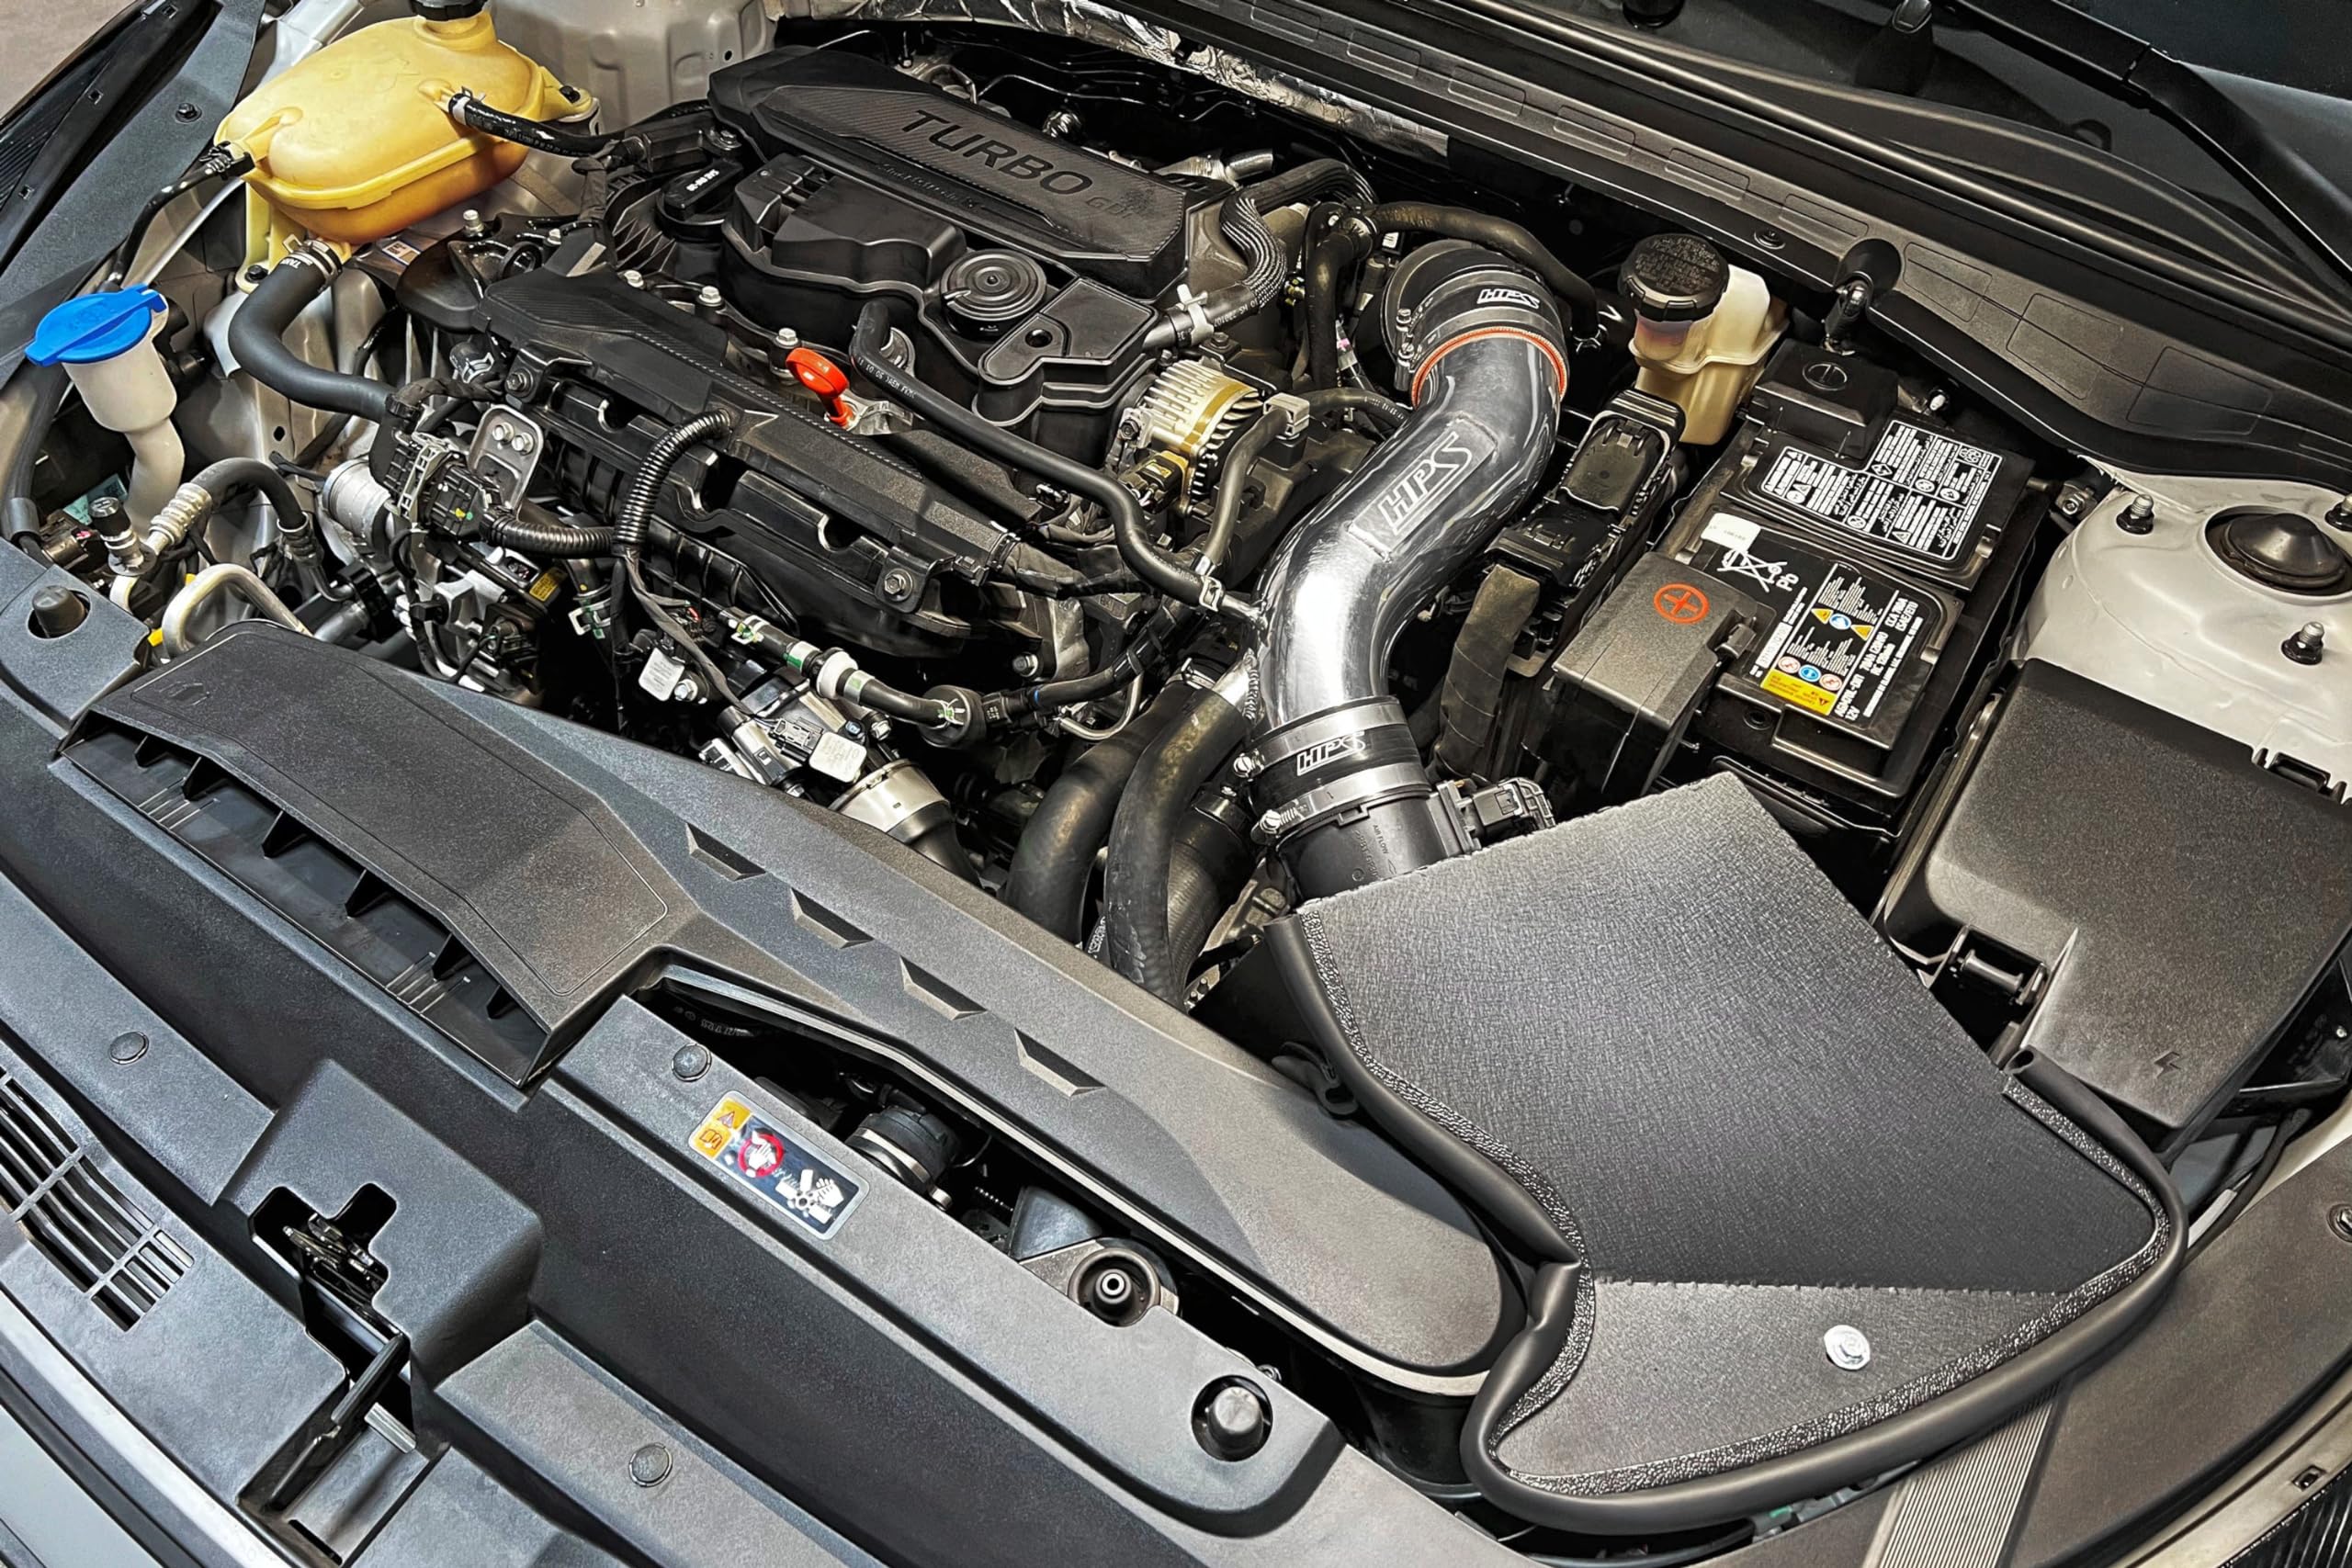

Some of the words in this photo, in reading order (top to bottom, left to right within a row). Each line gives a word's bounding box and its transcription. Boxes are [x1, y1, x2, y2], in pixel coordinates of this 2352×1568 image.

[901, 109, 1093, 196] TURBO
[1476, 288, 1541, 310] HPS
[1377, 431, 1474, 536] HPS
[1776, 572, 1800, 592] Pb
[1296, 730, 1366, 777] HPS
